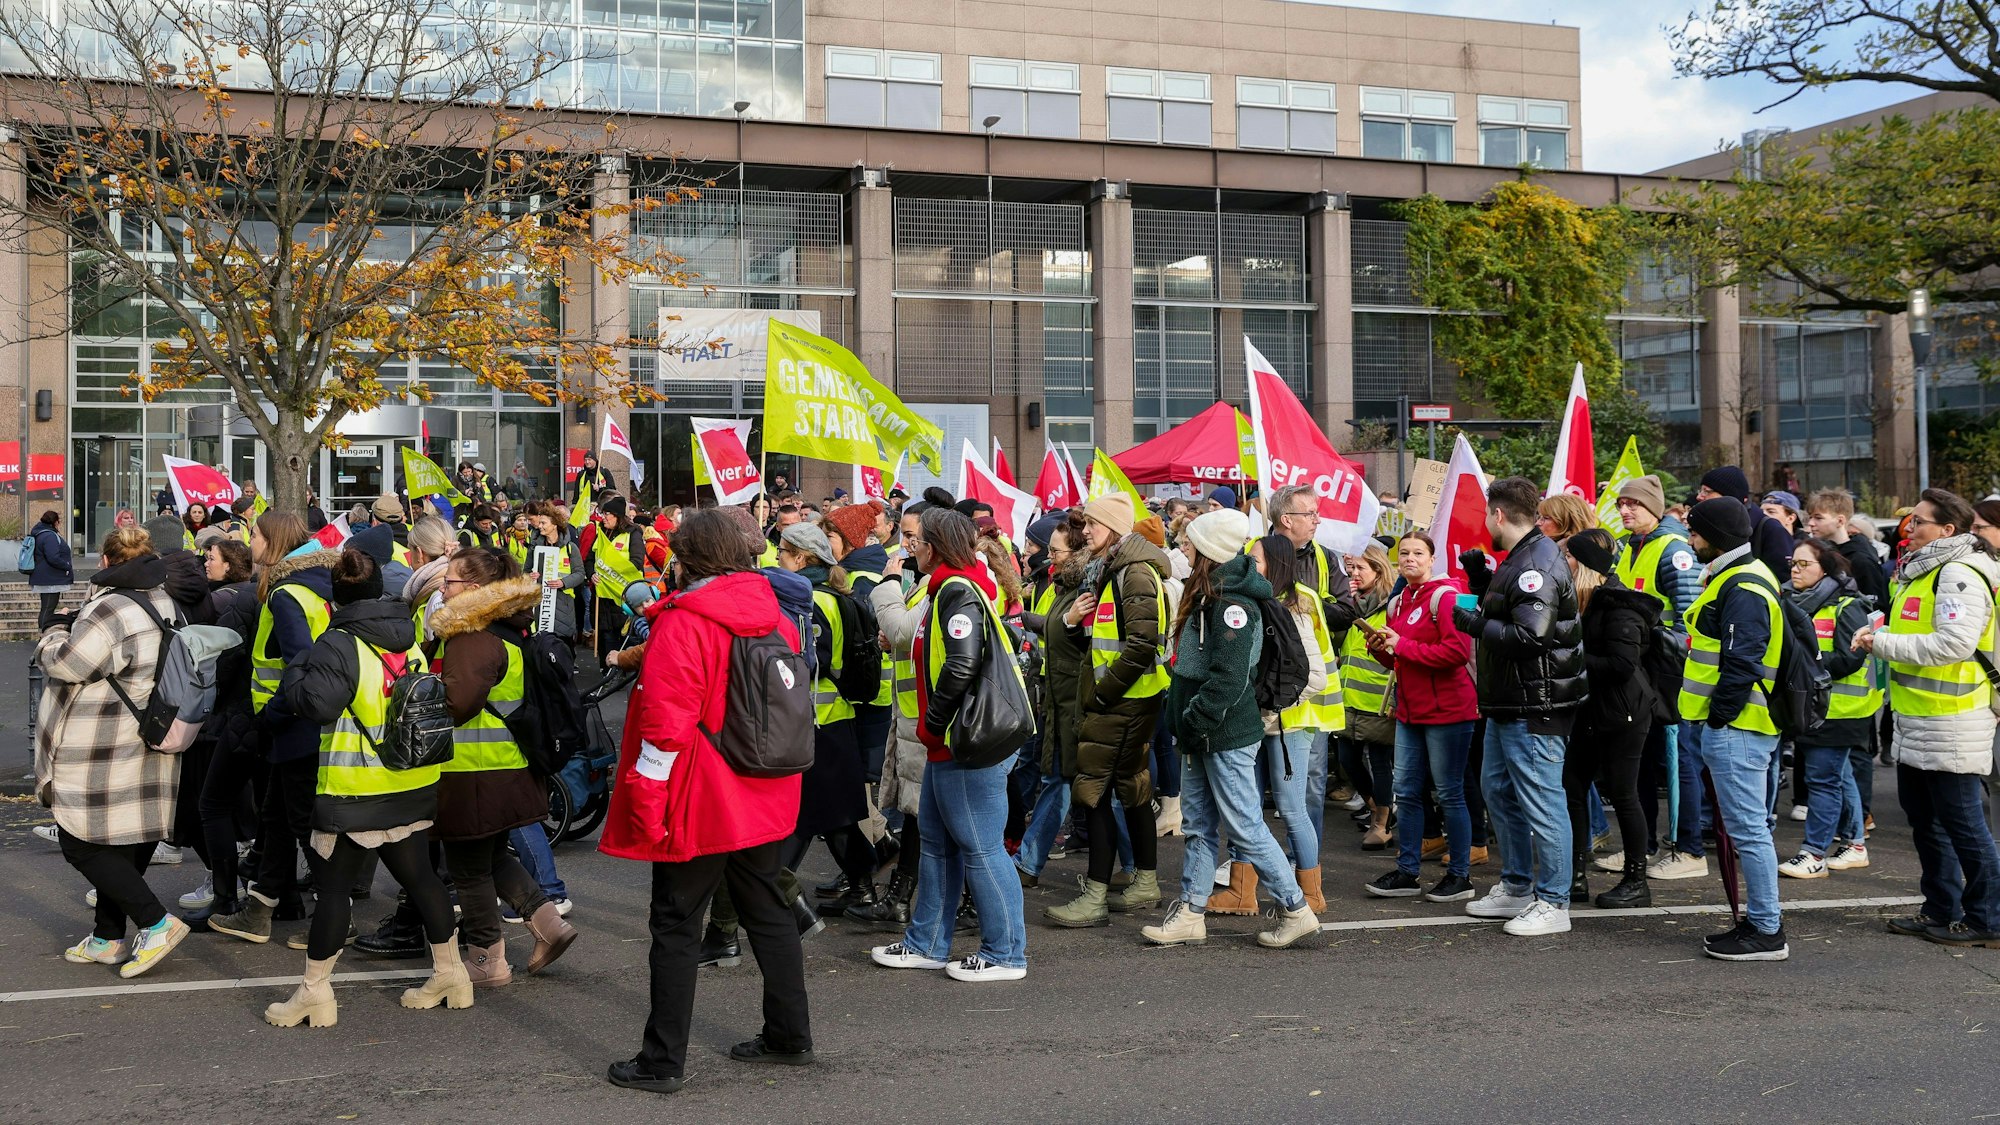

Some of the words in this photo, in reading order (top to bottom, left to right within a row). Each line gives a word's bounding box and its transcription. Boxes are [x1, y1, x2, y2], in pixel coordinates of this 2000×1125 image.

[669, 319, 767, 343] ZUSAMME
[682, 343, 734, 363] HALT
[778, 358, 911, 438] GEMEINSAM
[794, 400, 873, 444] STARK
[340, 448, 374, 456] Eingang
[27, 474, 63, 482] STREIK
[185, 489, 231, 502] ver.di
[1426, 484, 1441, 495] BEZ
